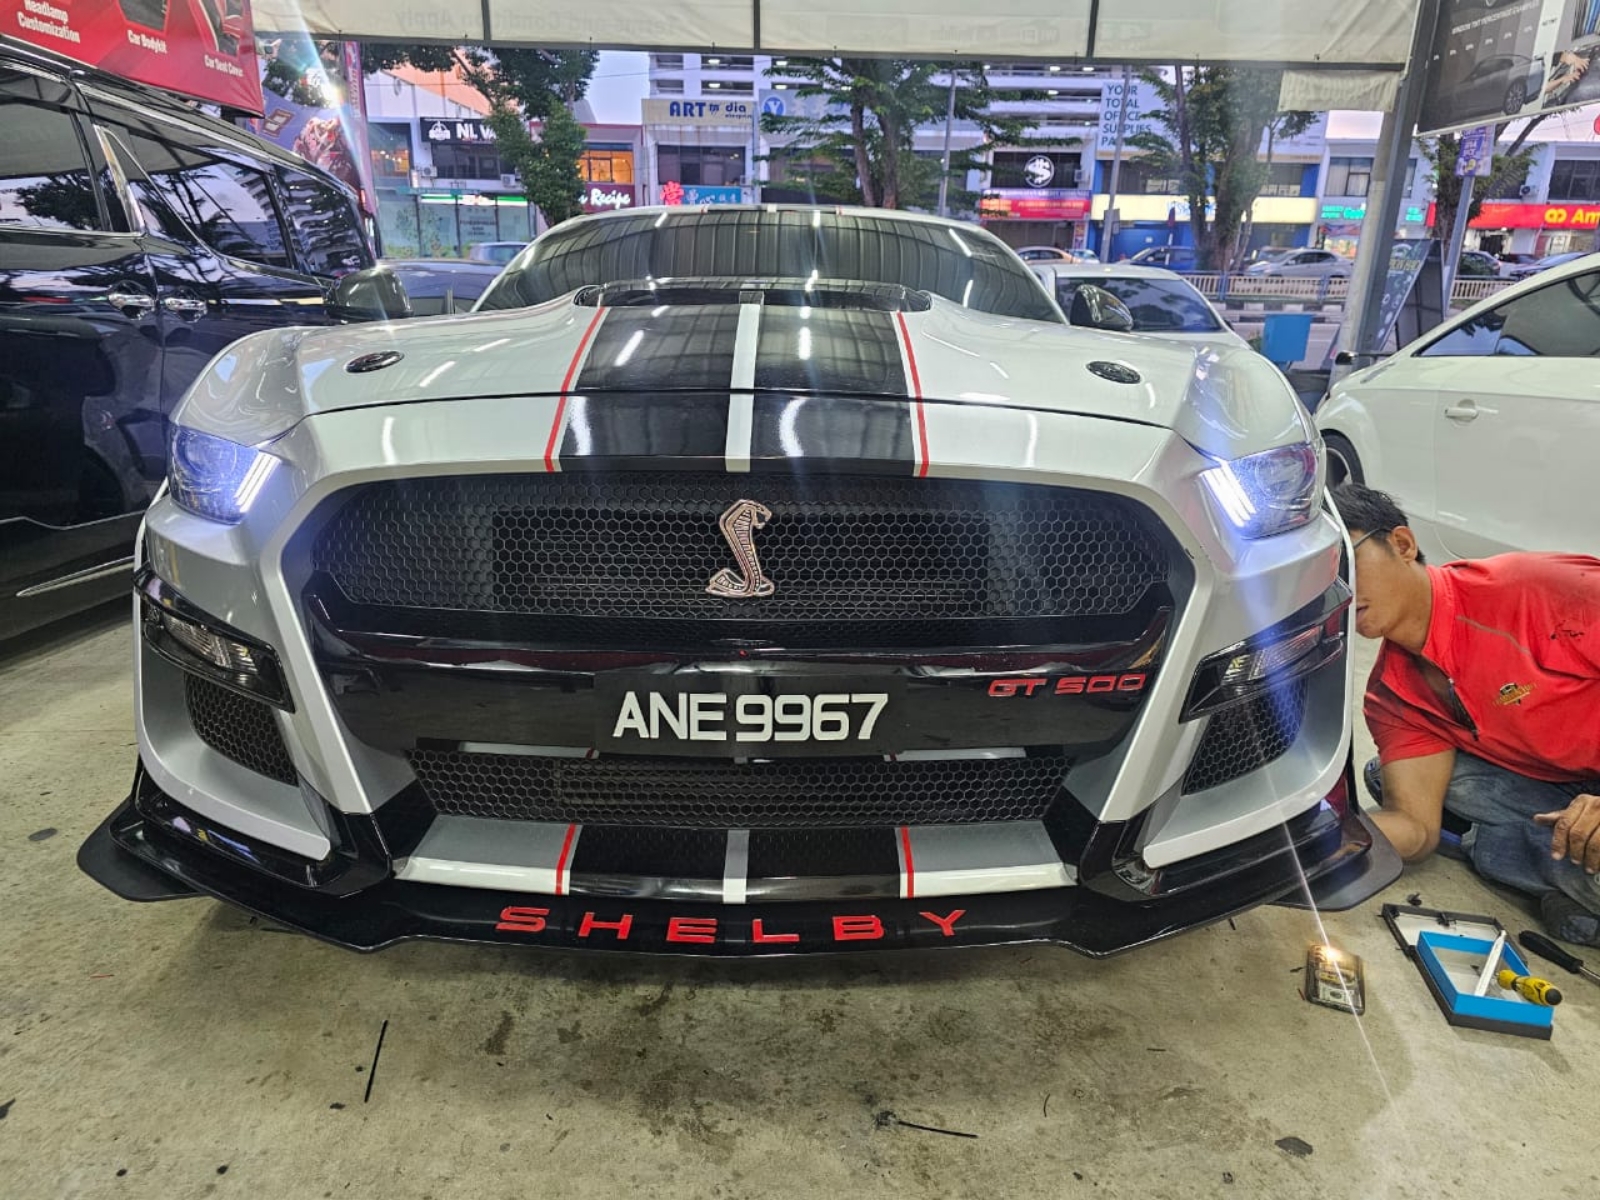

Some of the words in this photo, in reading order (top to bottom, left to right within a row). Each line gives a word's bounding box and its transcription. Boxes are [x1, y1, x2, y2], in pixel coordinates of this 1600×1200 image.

[17, 11, 81, 44] Customization
[128, 29, 141, 45] Car
[669, 101, 706, 117] ART
[1102, 123, 1152, 135] SUPLIES
[591, 188, 630, 209] Recipe
[988, 678, 1048, 697] GT
[1054, 673, 1147, 695] 500
[612, 691, 727, 741] ANE
[735, 693, 889, 742] 9967
[495, 905, 967, 944] SHELBY
